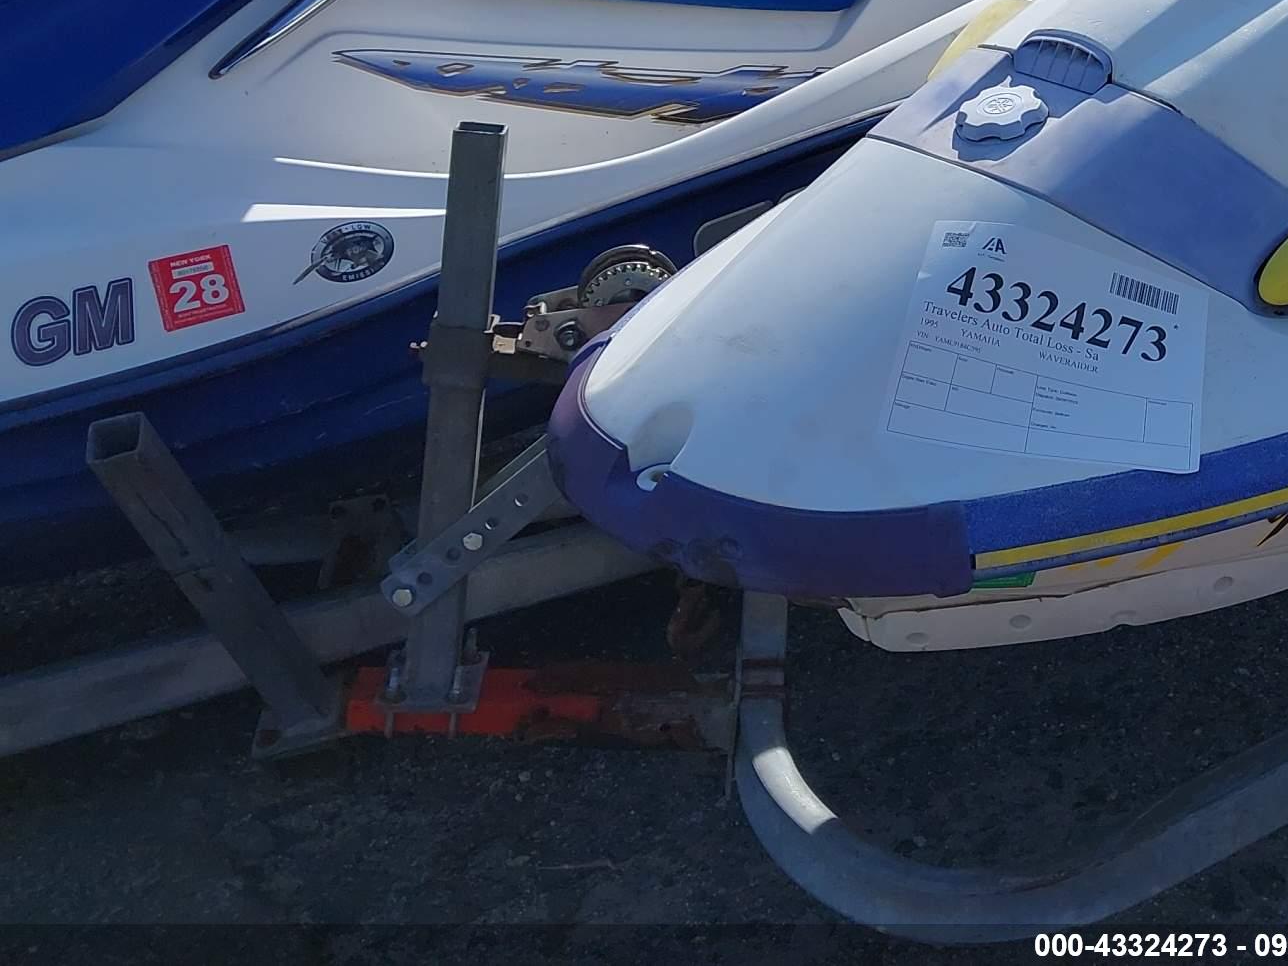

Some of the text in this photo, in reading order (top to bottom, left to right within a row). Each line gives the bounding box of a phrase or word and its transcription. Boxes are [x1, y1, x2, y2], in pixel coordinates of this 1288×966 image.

[11, 277, 135, 367] GM
[169, 273, 230, 313] 28
[946, 266, 1168, 362] 43324273
[919, 317, 1099, 374] 1995 YAMAHA WAVERAIDER
[923, 300, 979, 326] Travelers
[980, 318, 1011, 335] Auto
[1014, 326, 1044, 346] Total
[1047, 336, 1074, 355] Loss
[1084, 347, 1100, 362] Sa
